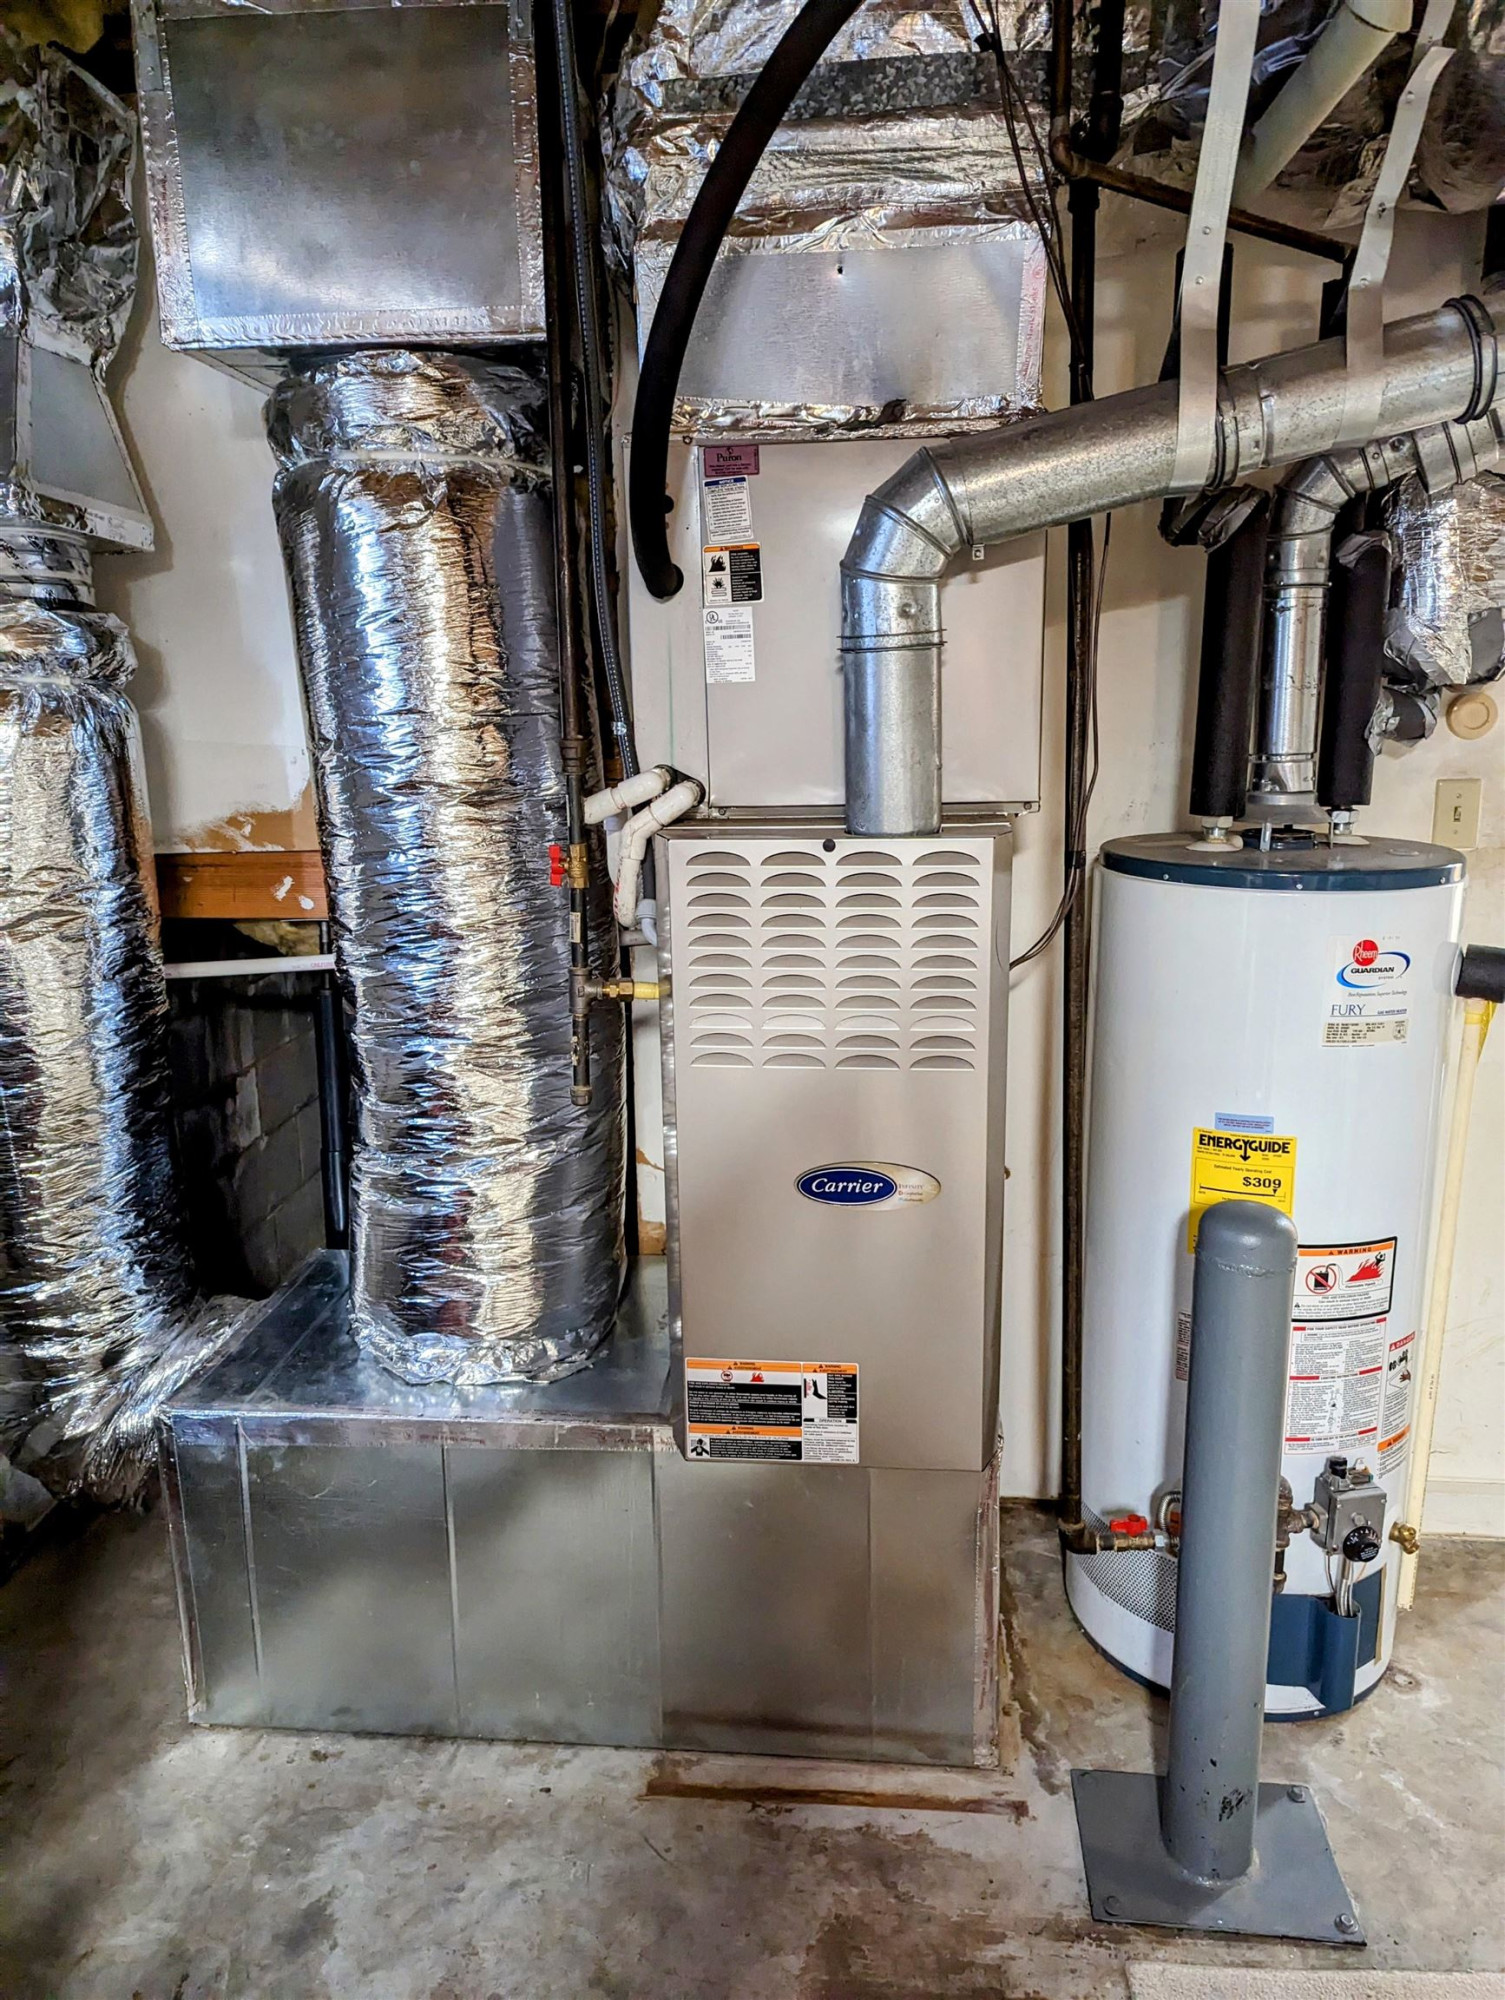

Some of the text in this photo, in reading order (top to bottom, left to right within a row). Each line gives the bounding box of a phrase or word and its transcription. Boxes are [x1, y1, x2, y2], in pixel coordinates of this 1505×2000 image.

[717, 453, 742, 462] Puron
[1353, 940, 1378, 962] Rheem
[1331, 1004, 1366, 1016] FURY
[1199, 1133, 1291, 1154] ENERGYGUIDE
[811, 1178, 884, 1194] Carrier
[1242, 1176, 1282, 1188] $309
[1337, 1246, 1372, 1255] WARNING
